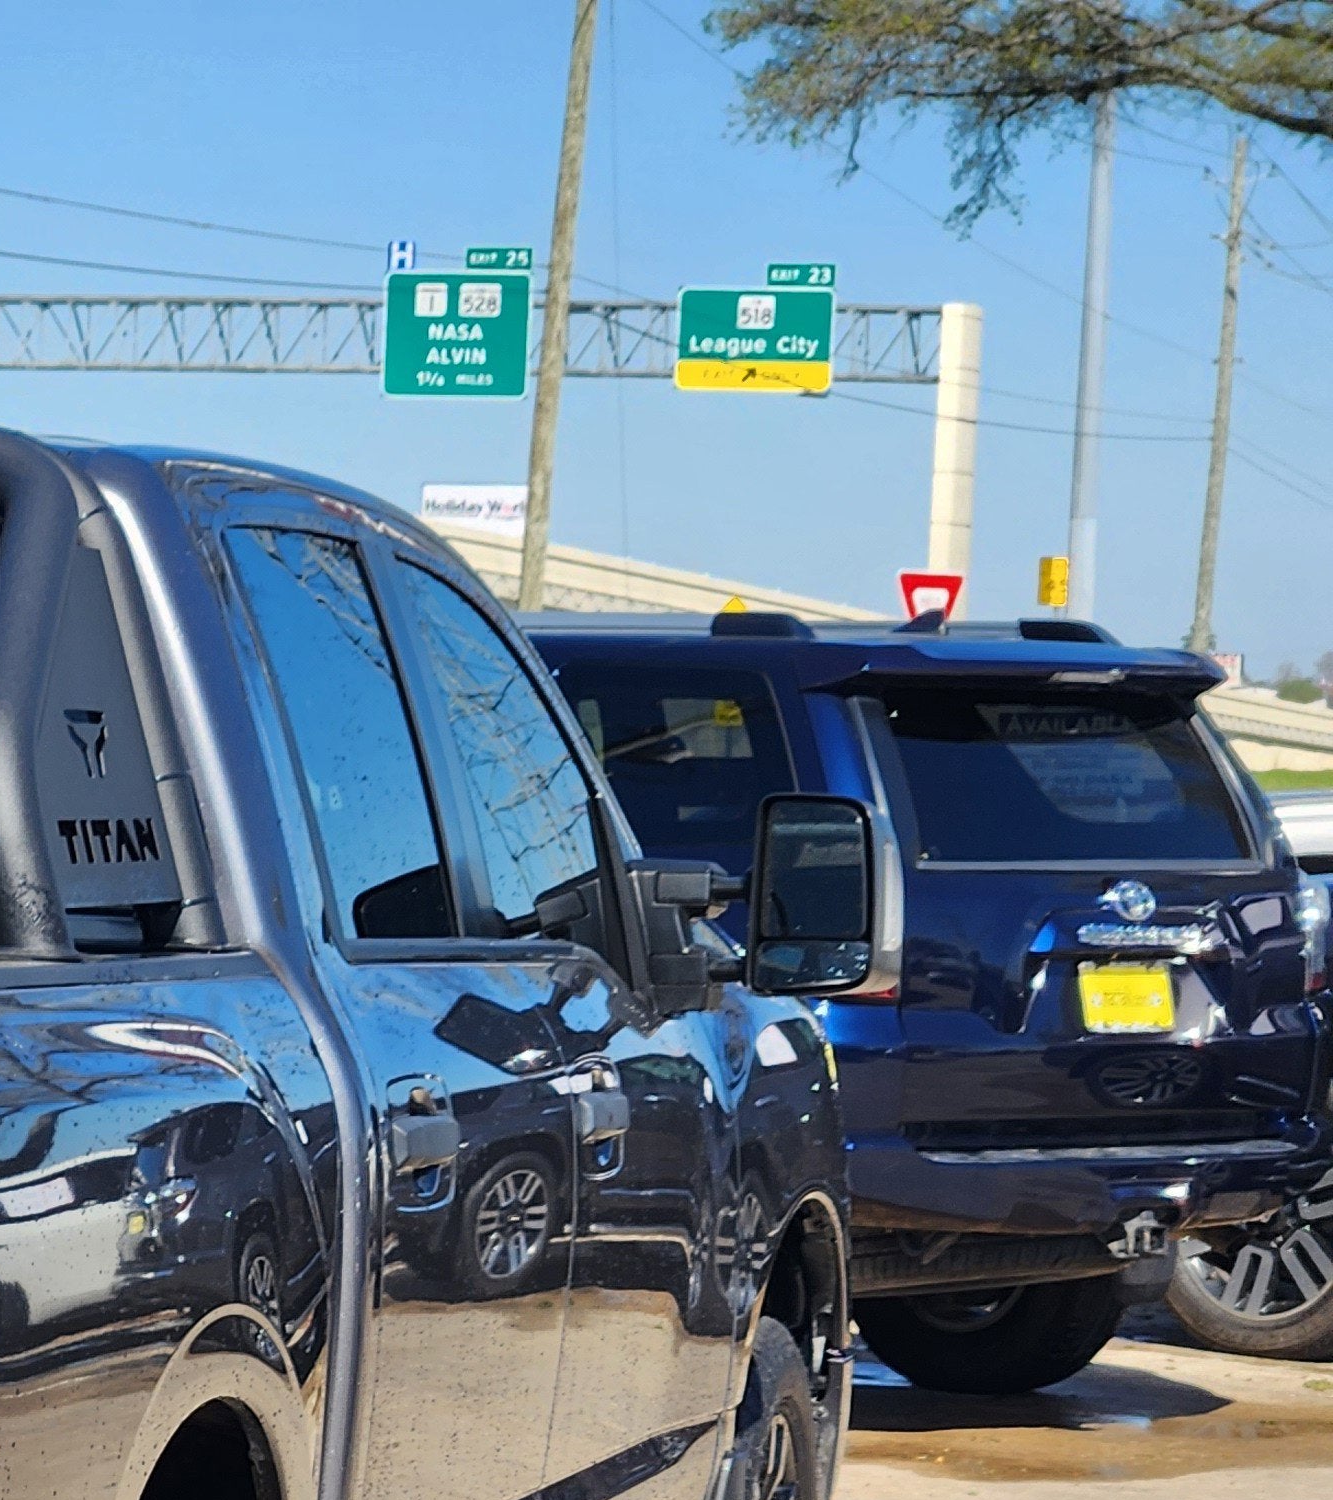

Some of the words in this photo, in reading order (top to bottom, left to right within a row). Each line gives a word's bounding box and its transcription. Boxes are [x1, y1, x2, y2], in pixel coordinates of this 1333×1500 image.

[770, 268, 800, 281] EXIT
[808, 267, 831, 284] 23
[463, 295, 498, 313] 528
[741, 306, 772, 325] 518
[428, 323, 483, 340] NASA
[426, 347, 487, 365] ALVIN
[689, 335, 767, 357] League
[776, 335, 819, 359] City
[487, 500, 525, 516] Worl
[57, 818, 160, 864] TITAN
